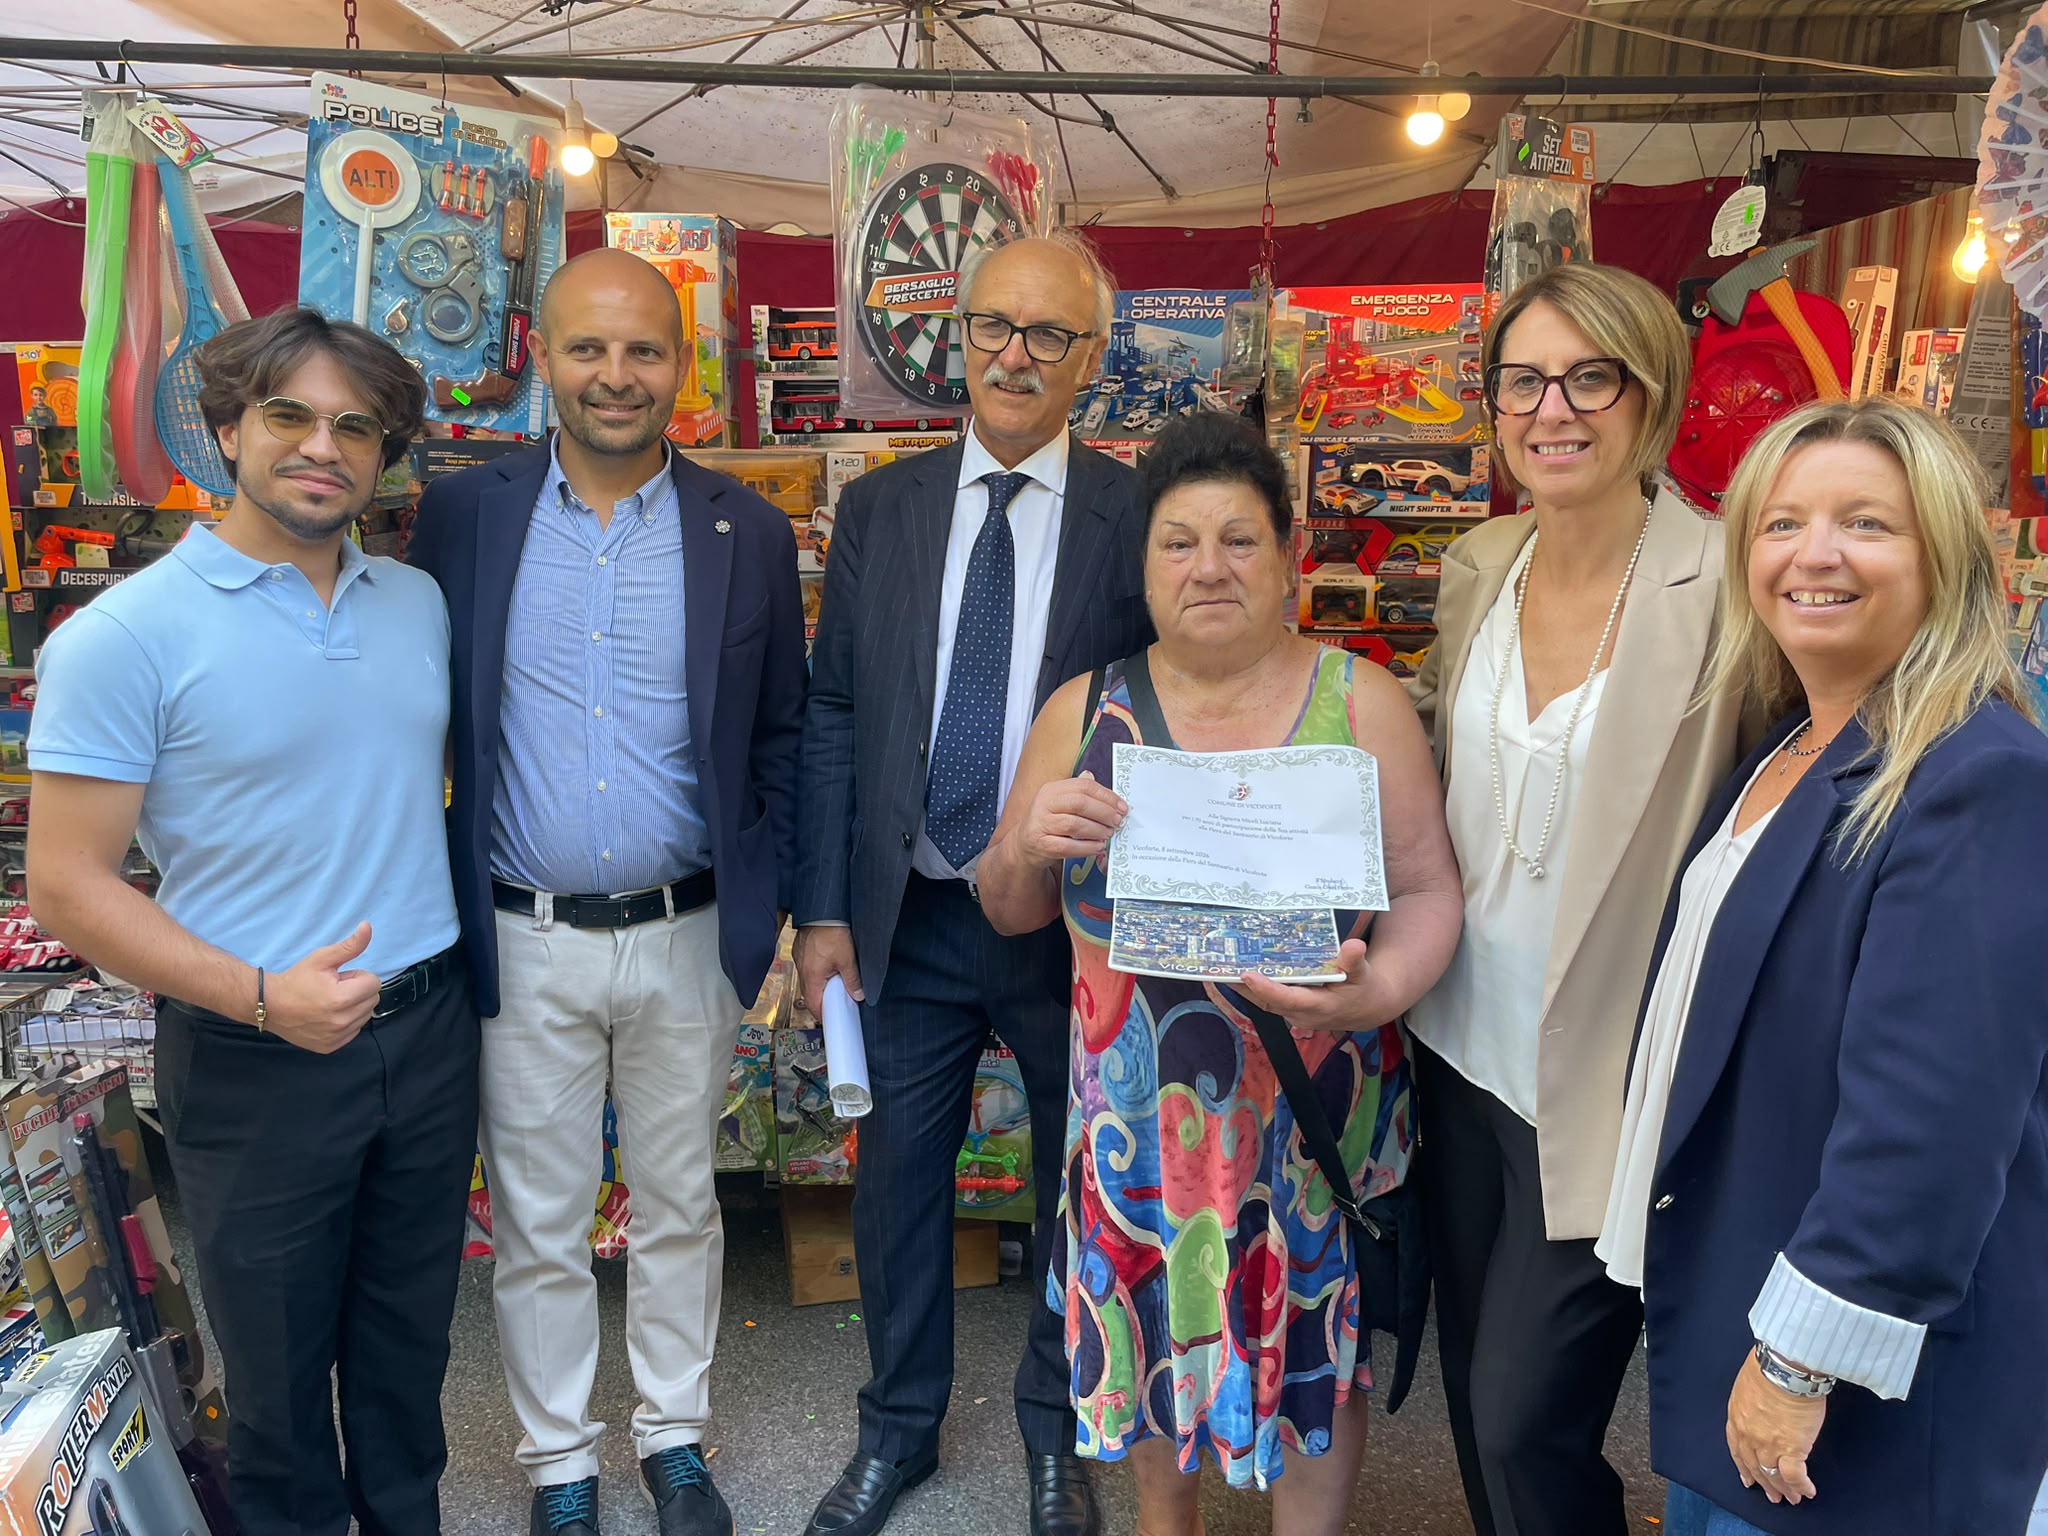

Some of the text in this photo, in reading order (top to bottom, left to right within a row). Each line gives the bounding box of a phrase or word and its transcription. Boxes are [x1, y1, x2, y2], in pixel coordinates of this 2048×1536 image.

[324, 100, 442, 137] POLICE
[462, 122, 498, 138] POSTO
[464, 130, 507, 150] BLOCCO
[1542, 134, 1562, 156] SET
[1530, 154, 1572, 176] ATTREZZI
[350, 168, 394, 190] ALT!
[919, 174, 929, 186] 12
[946, 170, 954, 183] 5
[966, 176, 980, 192] 20
[898, 189, 906, 200] 9
[992, 195, 998, 206] 1
[880, 214, 888, 226] 14
[1007, 219, 1017, 232] 18
[678, 232, 709, 249] YARD
[869, 244, 879, 257] 11
[883, 276, 955, 295] BERSAGLIO
[883, 286, 957, 306] FRECCETTE
[1132, 296, 1227, 307] CENTRALE
[1351, 294, 1455, 306] EMERGENZA
[1130, 308, 1226, 320] OPERATIVA
[1373, 306, 1430, 317] FUOCO
[872, 312, 882, 326] 16
[512, 318, 521, 340] POWER
[888, 346, 896, 358] 7
[904, 368, 916, 382] 19
[928, 384, 936, 396] 3
[951, 388, 963, 400] 17
[1390, 504, 1415, 512] NIGHT
[1416, 504, 1452, 512] SHIFTER
[1258, 966, 1294, 976] (CN)
